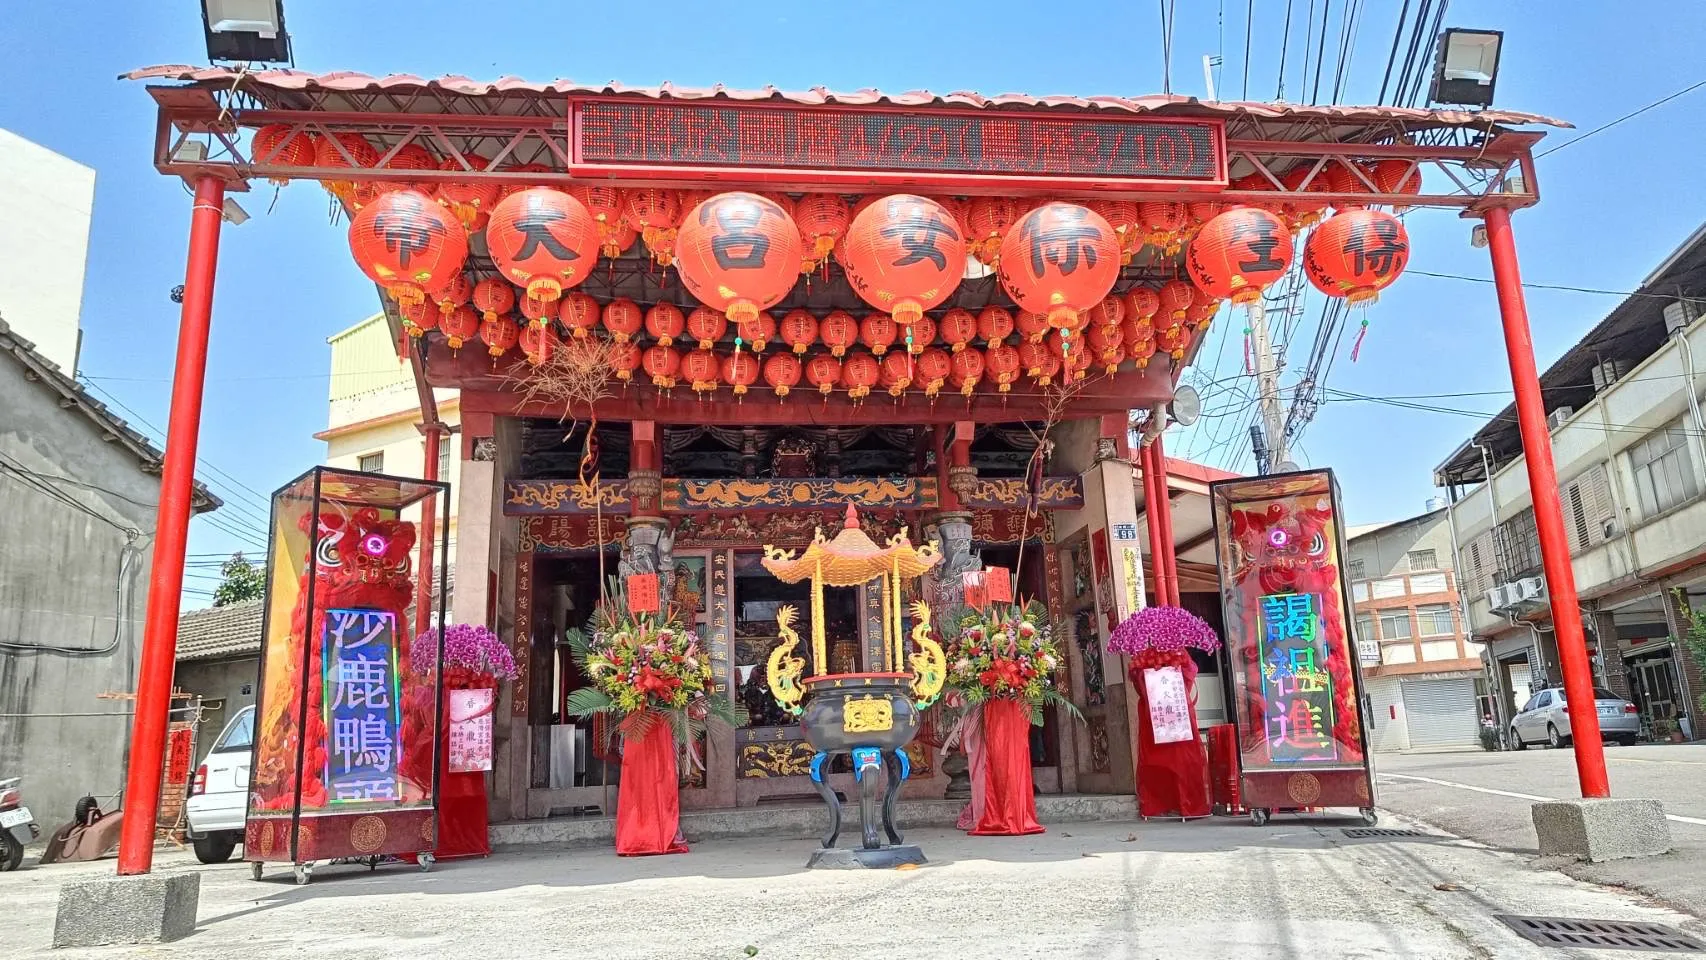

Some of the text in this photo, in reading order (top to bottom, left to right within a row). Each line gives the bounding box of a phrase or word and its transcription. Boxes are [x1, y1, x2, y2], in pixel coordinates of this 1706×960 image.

[374, 192, 447, 270] 帝
[512, 193, 581, 262] 大
[699, 194, 786, 270] 宮
[880, 197, 959, 272] 安
[1230, 211, 1286, 273] 生
[1343, 217, 1407, 277] 保
[1121, 530, 1133, 539] 98
